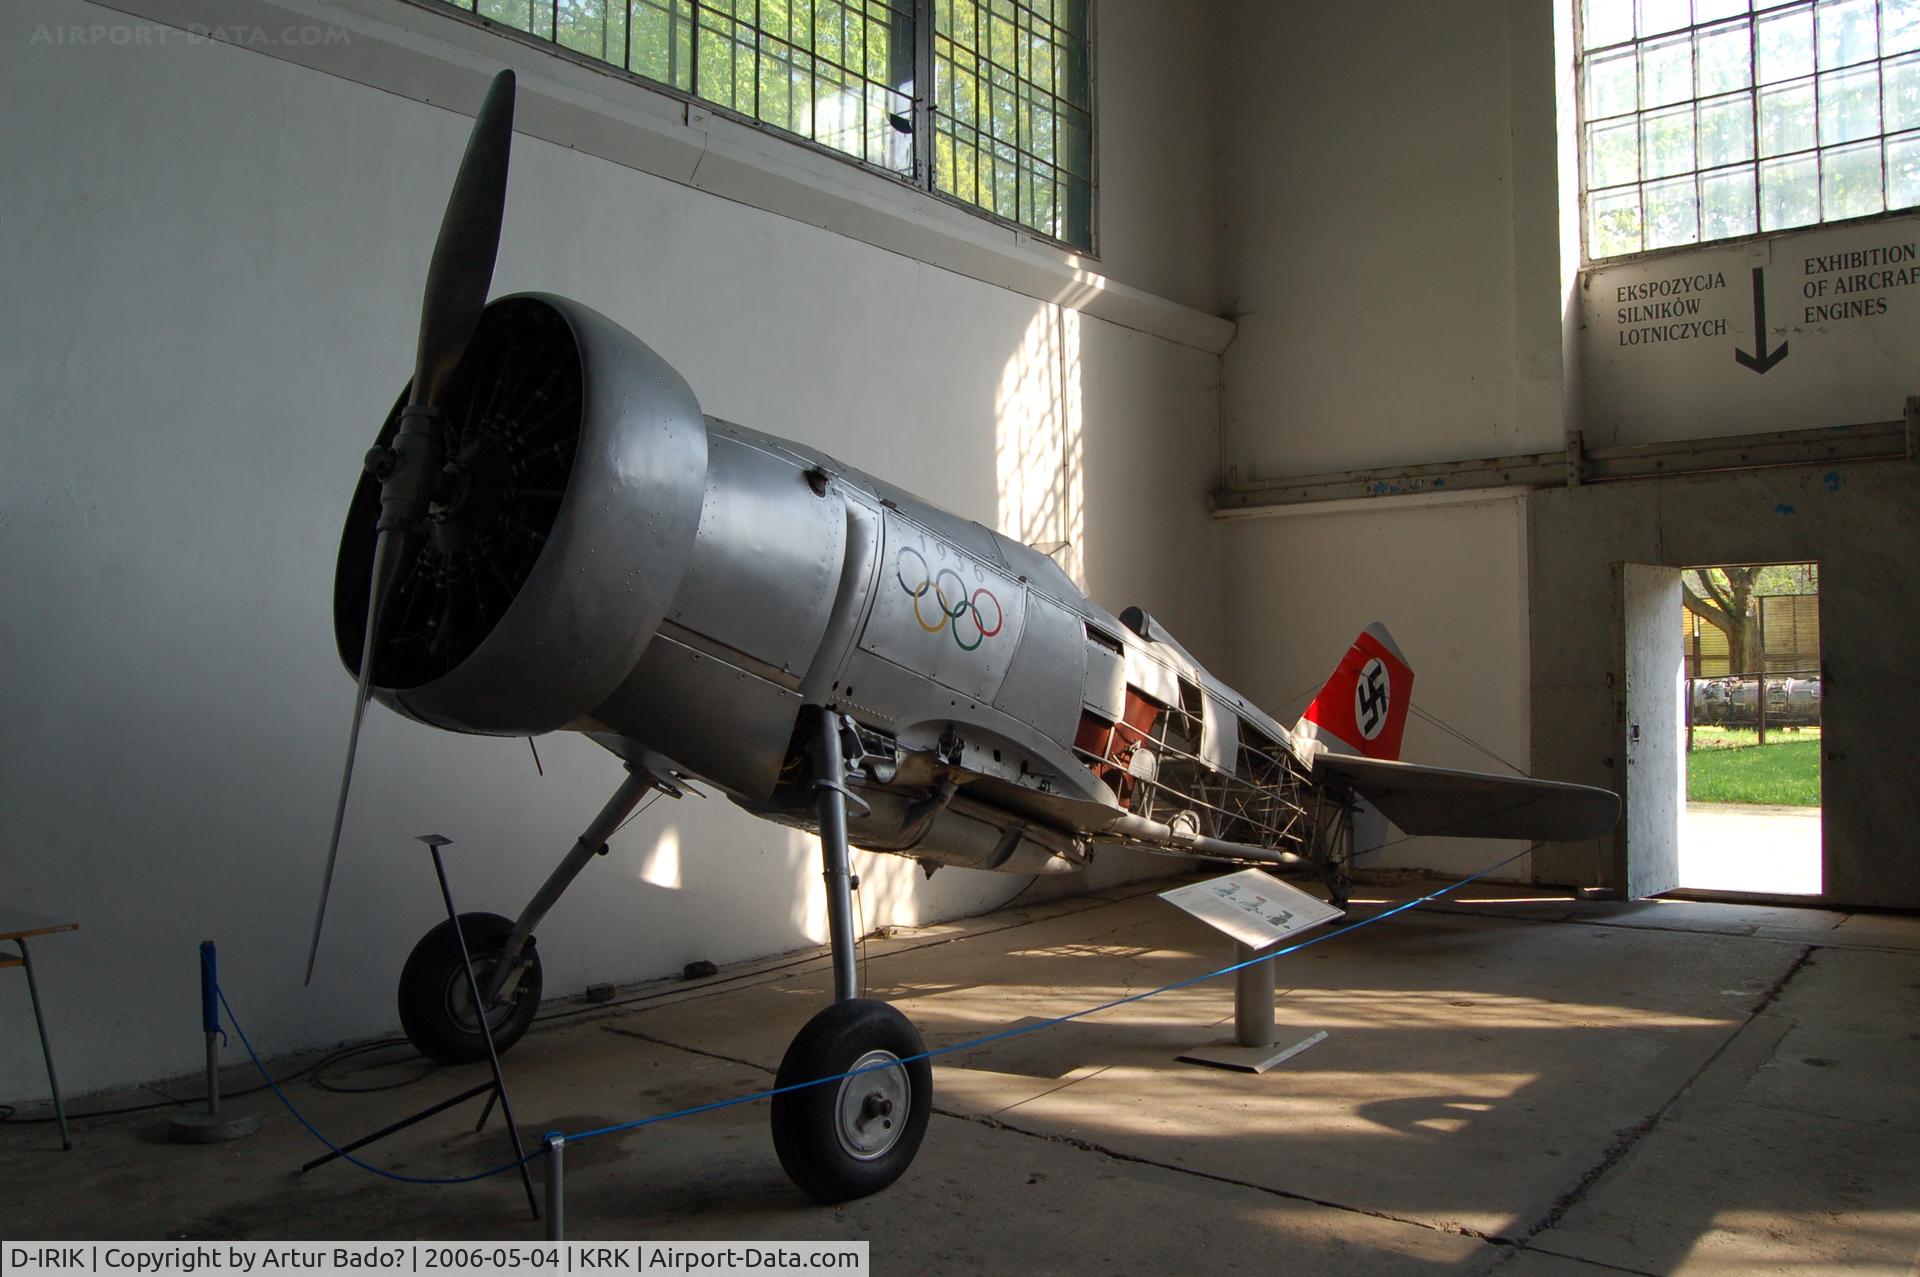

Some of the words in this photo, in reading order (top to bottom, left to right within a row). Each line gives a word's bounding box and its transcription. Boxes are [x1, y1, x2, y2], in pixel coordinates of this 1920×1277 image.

[1804, 243, 1916, 275] EXHIBITION
[1616, 271, 1726, 303] EKSPOZYCJA
[1803, 280, 1828, 299] OF
[1834, 266, 1920, 295] AIRCRAF
[1617, 297, 1701, 325] SILNIKÓW
[1804, 297, 1887, 324] ENGINES
[1618, 318, 1727, 347] LOTNICZYCH
[918, 534, 985, 582] 1936
